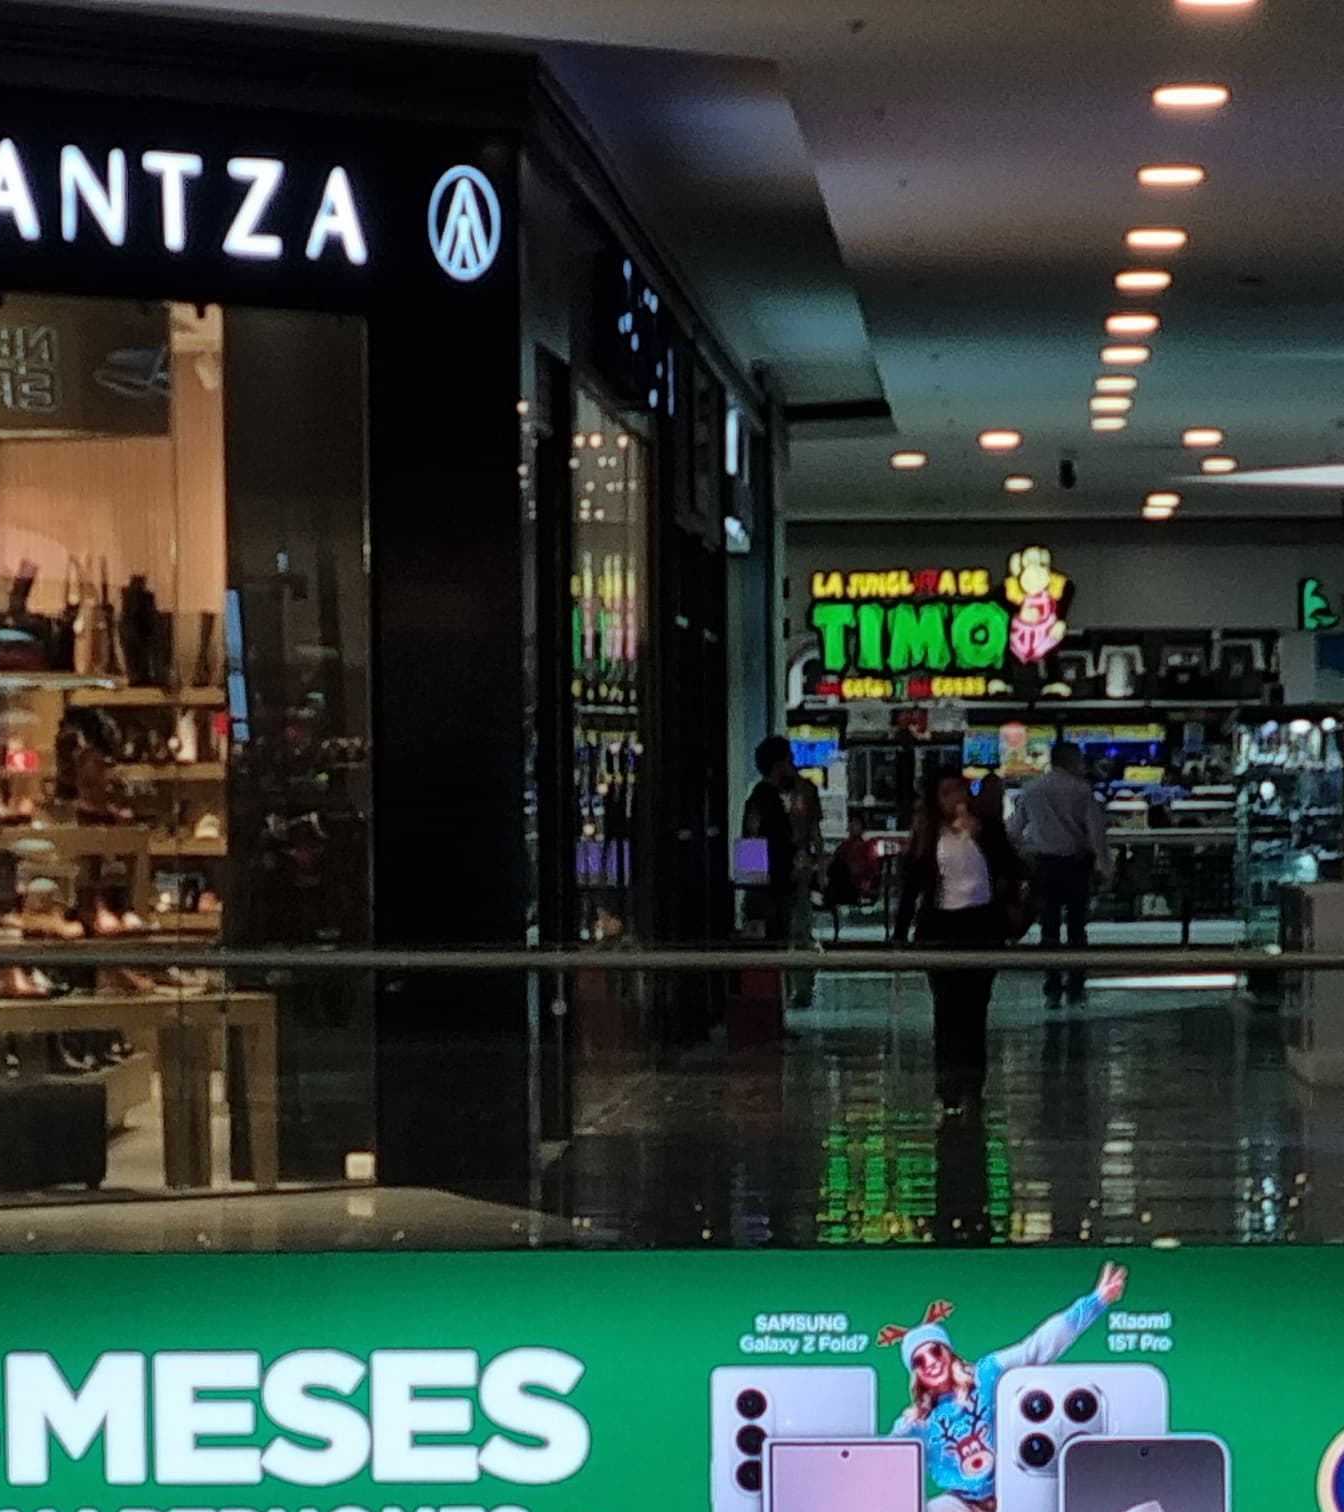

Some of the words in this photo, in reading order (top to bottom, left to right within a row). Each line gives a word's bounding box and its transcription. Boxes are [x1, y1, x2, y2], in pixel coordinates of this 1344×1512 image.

[812, 600, 1009, 672] TIMO
[754, 1313, 848, 1334] SAMSUNG
[1108, 1311, 1173, 1331] Xiaomi
[739, 1335, 800, 1355] Galaxy
[802, 1335, 817, 1352] Z
[819, 1335, 870, 1353] Fold7
[1143, 1335, 1173, 1352] Pro
